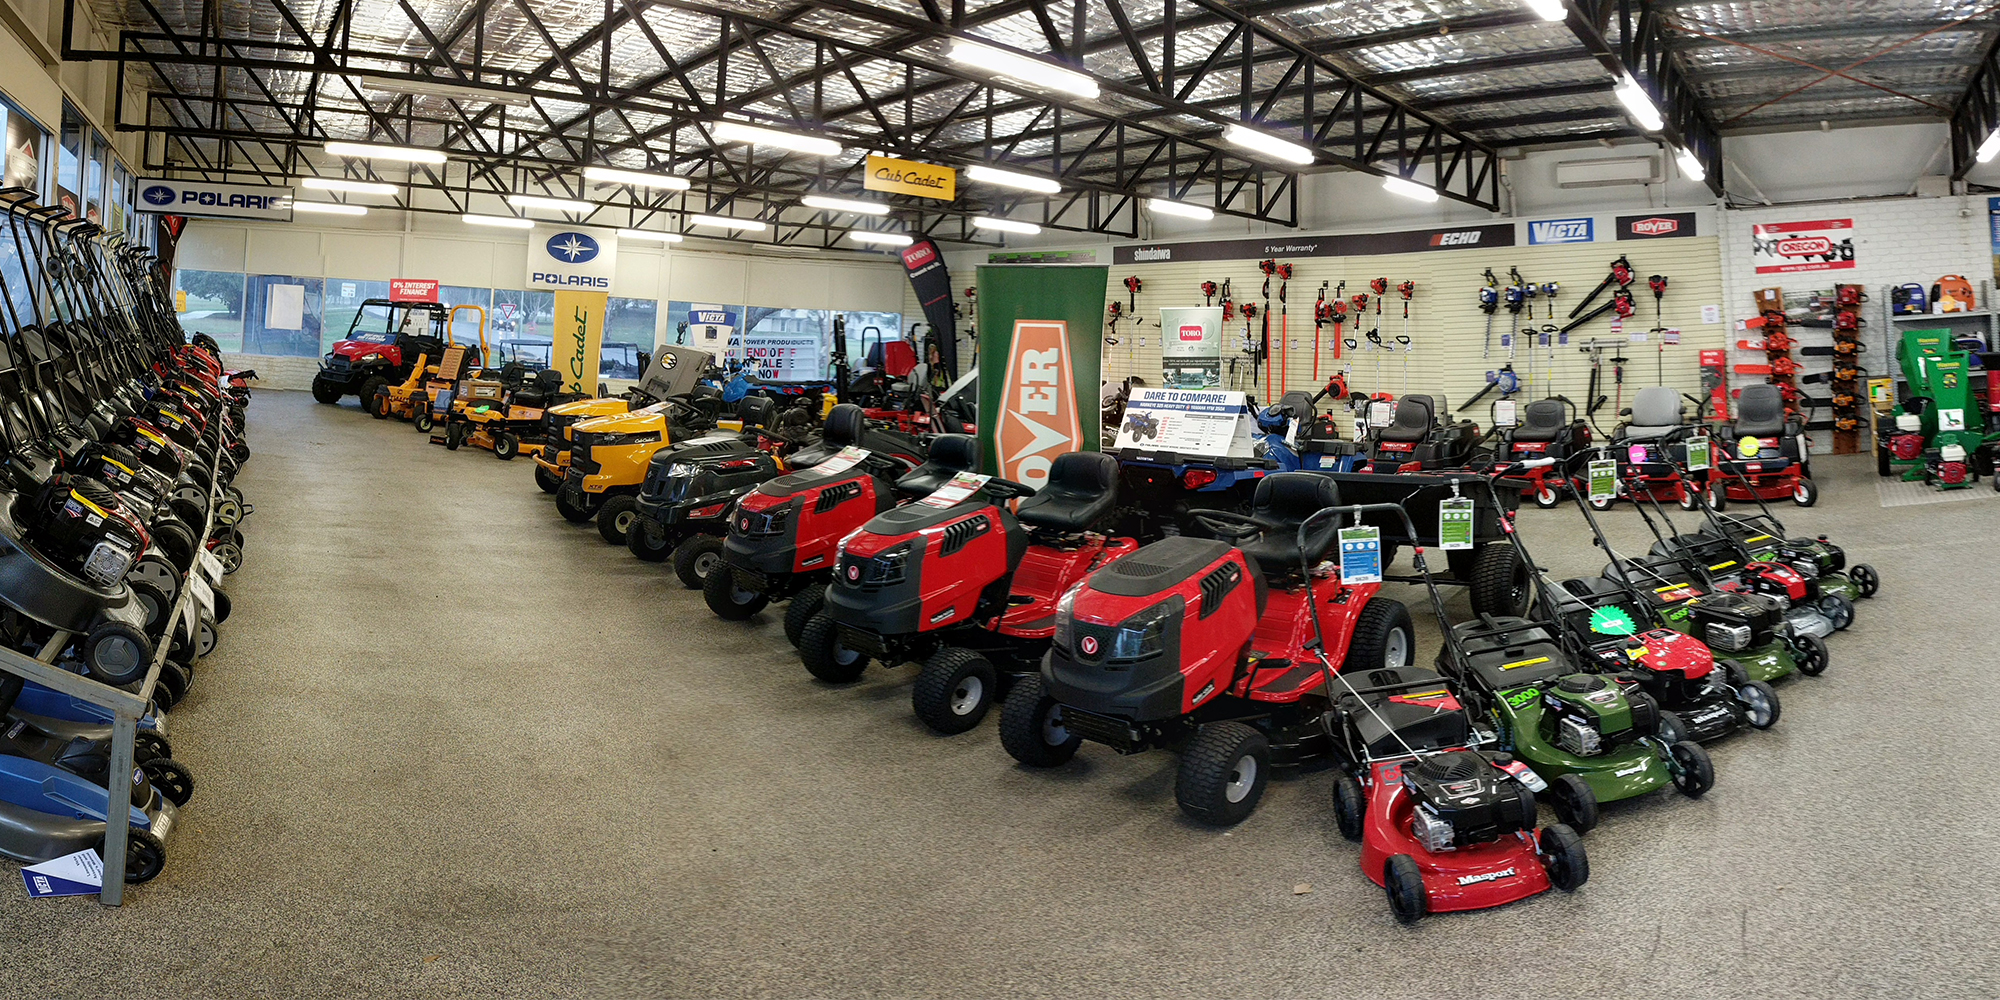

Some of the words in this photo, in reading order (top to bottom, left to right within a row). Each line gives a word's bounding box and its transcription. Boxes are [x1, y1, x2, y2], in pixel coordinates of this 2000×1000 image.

[874, 167, 902, 182] Cub
[903, 171, 947, 189] Cadet
[181, 190, 284, 210] POLARIS
[1532, 222, 1588, 242] VICTA
[1635, 221, 1673, 233] ROVER
[1439, 230, 1482, 246] ECHO
[1134, 246, 1171, 262] shindaiwa
[1270, 245, 1284, 253] Year
[1782, 241, 1825, 252] OREGON
[904, 247, 932, 263] TORO
[392, 281, 404, 289] 0%
[404, 282, 436, 290] INTEREST
[532, 272, 609, 288] POLARIS
[399, 288, 429, 296] FINANCE
[697, 311, 727, 323] VICTA
[1181, 329, 1202, 337] TORO
[569, 305, 588, 380] Cadet
[747, 348, 768, 357] END
[758, 369, 780, 379] NOW
[1143, 391, 1166, 401] DARE
[1168, 392, 1179, 401] TO
[1179, 393, 1227, 404] COMPARE!
[1005, 347, 1072, 490] OVER
[1507, 688, 1540, 707] 3000
[1457, 868, 1515, 886] Masport
